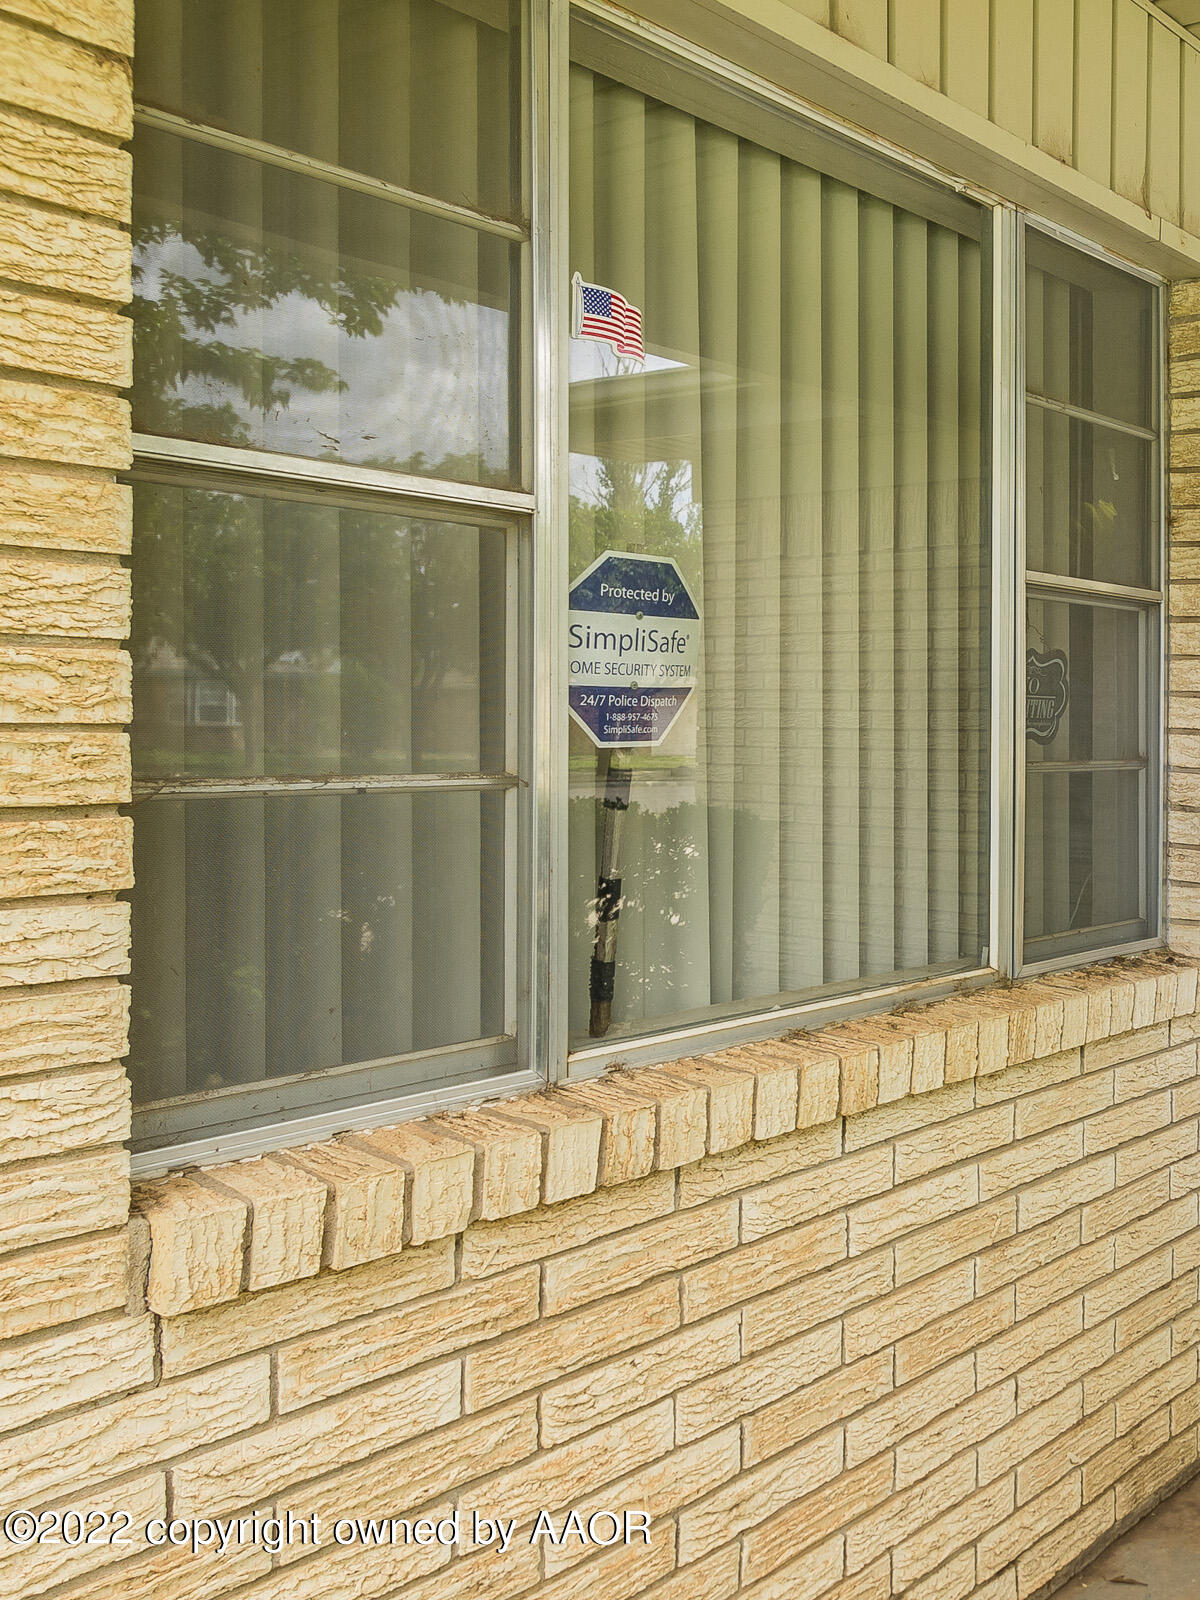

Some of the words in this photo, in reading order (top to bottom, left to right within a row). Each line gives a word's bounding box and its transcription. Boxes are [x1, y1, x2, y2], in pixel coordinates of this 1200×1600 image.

[600, 583, 659, 602] Protected
[662, 592, 675, 606] by
[570, 660, 601, 675] OME
[604, 662, 657, 677] SECURITY
[659, 664, 691, 678] SYSTEM
[580, 695, 606, 706] 24/7
[608, 695, 638, 707] Police
[640, 696, 678, 709] Dispatch
[603, 725, 659, 735] SimpliSafe.com
